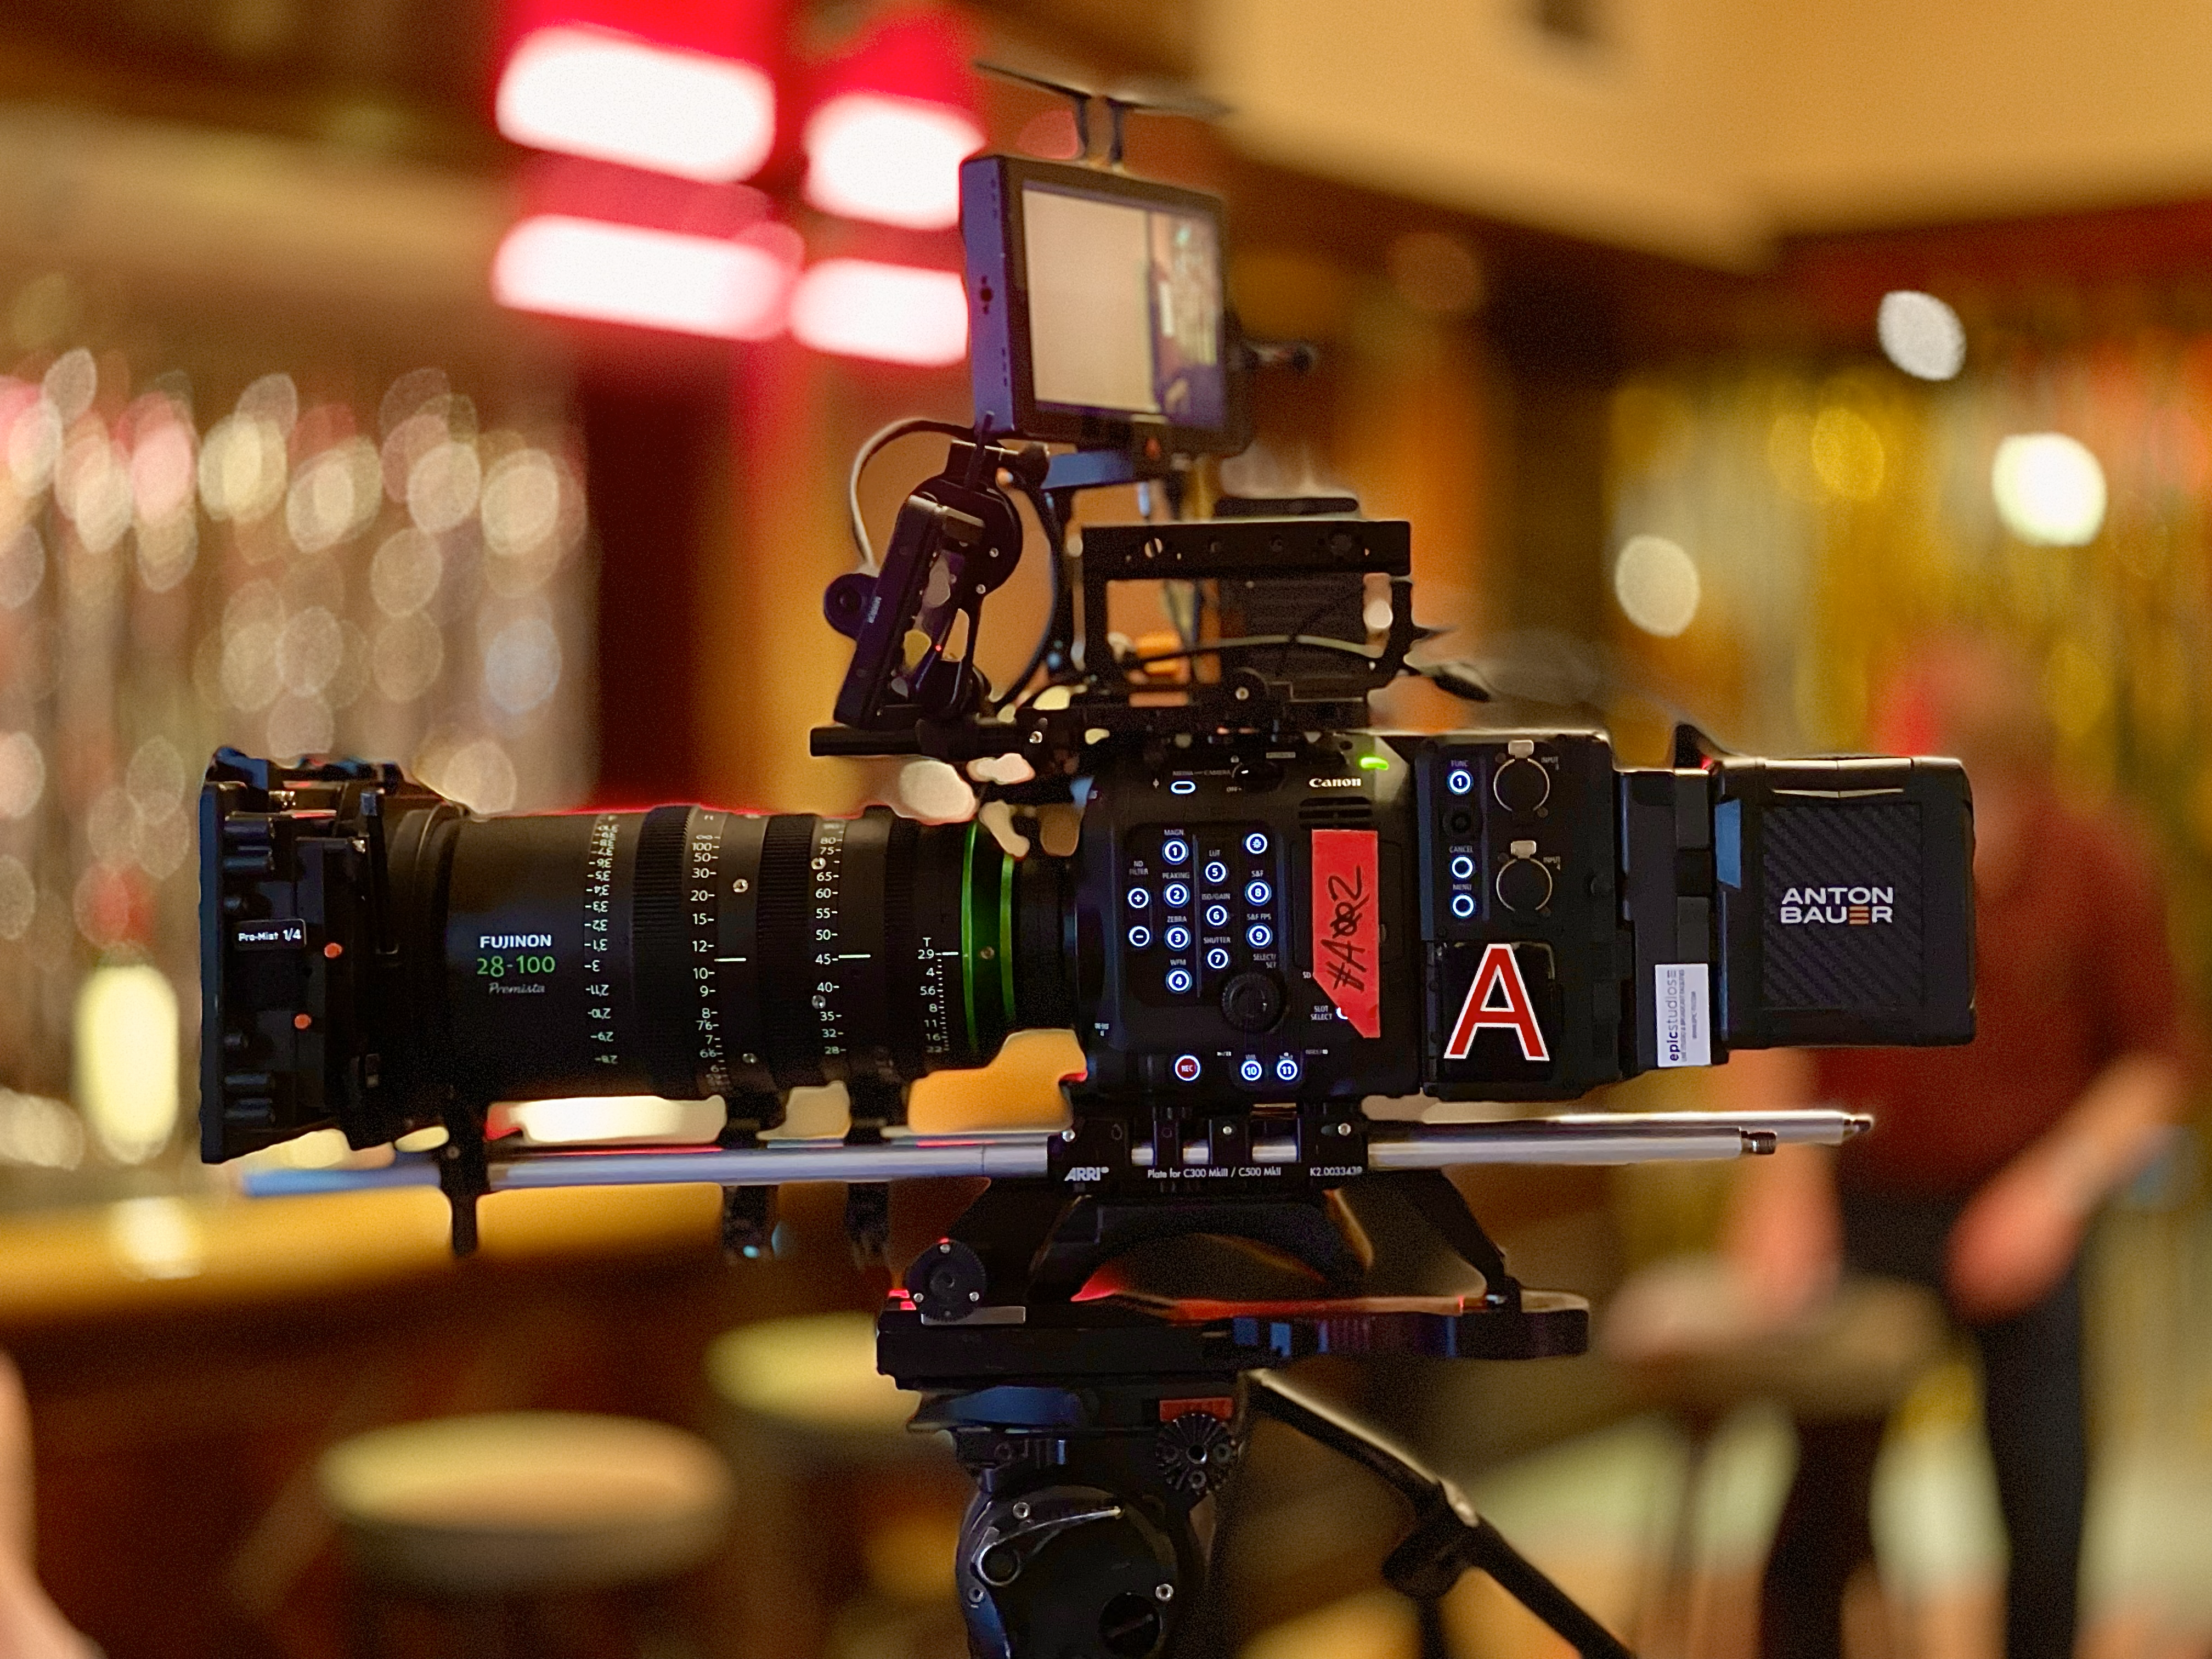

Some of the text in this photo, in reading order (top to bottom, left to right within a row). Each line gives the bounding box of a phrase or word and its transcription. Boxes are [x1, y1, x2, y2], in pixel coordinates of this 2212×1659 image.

[1309, 778, 1362, 788] Canon
[1457, 777, 1462, 787] 1
[692, 842, 712, 851] 100
[820, 847, 834, 855] 75
[1172, 847, 1177, 856] 1
[693, 852, 711, 862] 50
[692, 868, 709, 878] 30
[816, 871, 832, 882] 65
[1212, 867, 1218, 877] 5
[690, 890, 708, 901] 20
[815, 888, 831, 898] 60
[1173, 890, 1180, 899] 2
[1255, 888, 1262, 897] 8
[1781, 887, 1893, 905] ANTON
[816, 908, 831, 919] 55
[1213, 911, 1220, 920] 6
[1780, 906, 1893, 925] BAUER
[692, 913, 707, 925] 15
[283, 927, 302, 941] 1/4
[816, 929, 831, 940] 50
[1175, 934, 1181, 943] 3
[1256, 932, 1263, 940] 9
[479, 934, 552, 949] FUJINON
[692, 940, 707, 952] 12
[922, 937, 932, 947] T
[815, 953, 831, 965] 45
[1215, 955, 1221, 963] 7
[476, 955, 556, 978] 28-100
[592, 960, 601, 972] 3
[693, 967, 708, 979] 10
[926, 967, 935, 977] 4
[1175, 977, 1183, 985] 4
[489, 981, 545, 994] Premista
[699, 985, 709, 997] 9
[817, 981, 833, 992] 40
[1443, 943, 1550, 1061] A
[929, 1003, 938, 1012] 8
[702, 1008, 710, 1019] 8
[820, 1011, 834, 1021] 35
[821, 1029, 837, 1037] 32
[705, 1035, 713, 1045] 7
[825, 1046, 839, 1054] 28
[1246, 1066, 1257, 1075] 10
[1282, 1066, 1292, 1075] 11
[1148, 1169, 1167, 1178] Plate
[1170, 1167, 1181, 1178] for
[1183, 1168, 1206, 1178] C300
[1239, 1167, 1261, 1177] C500
